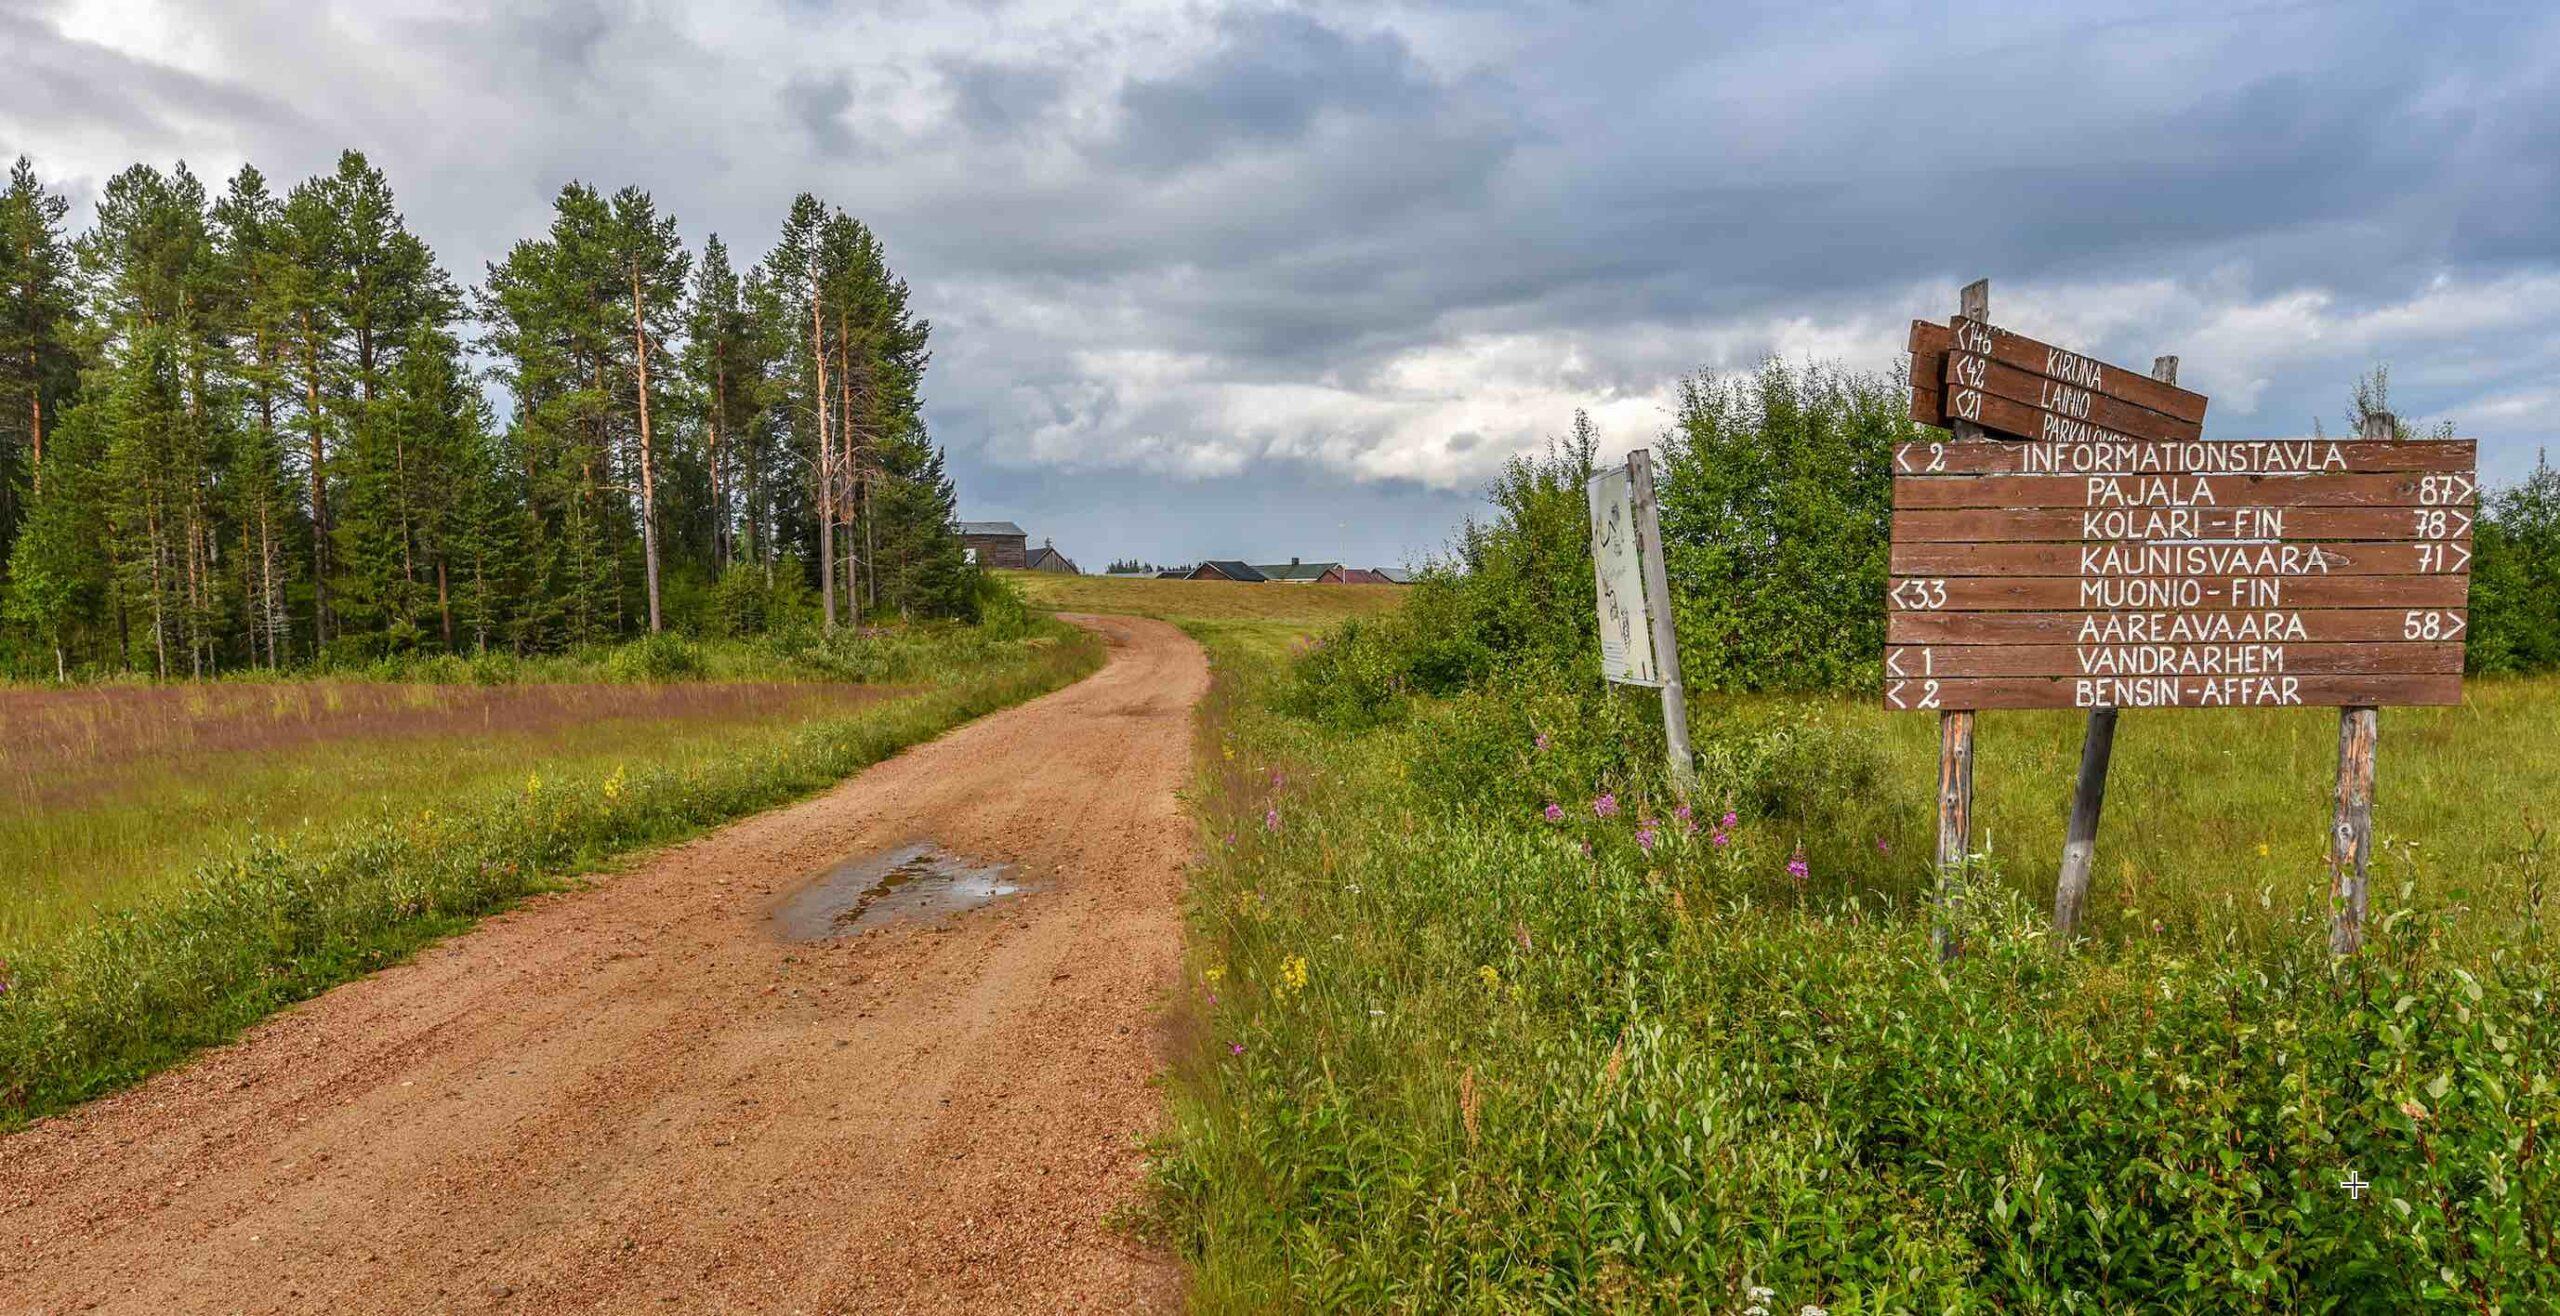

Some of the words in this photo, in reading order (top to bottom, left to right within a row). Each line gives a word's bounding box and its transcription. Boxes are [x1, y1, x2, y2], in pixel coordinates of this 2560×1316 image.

[1969, 322, 1992, 354] 146
[2046, 348, 2102, 391] KIRUNA
[1967, 356, 1985, 388] 42
[2041, 379, 2091, 419] LAINIO
[1967, 391, 1982, 421] 21
[1926, 443, 1946, 472] 2
[2022, 441, 2347, 473] INFORMATIONSTAVLA
[2087, 477, 2215, 506] PAJALA
[2420, 475, 2453, 506] 87
[2414, 509, 2447, 540] 78
[2081, 545, 2328, 575] KAUNISVAARA
[2414, 544, 2443, 573] 71
[1910, 579, 1947, 609] 33
[2078, 611, 2308, 642] AAREAVAARA
[2403, 610, 2440, 640] 58
[1921, 647, 1932, 676] 1
[2077, 645, 2283, 675] VANDRARHEM
[1917, 680, 1940, 709] 2
